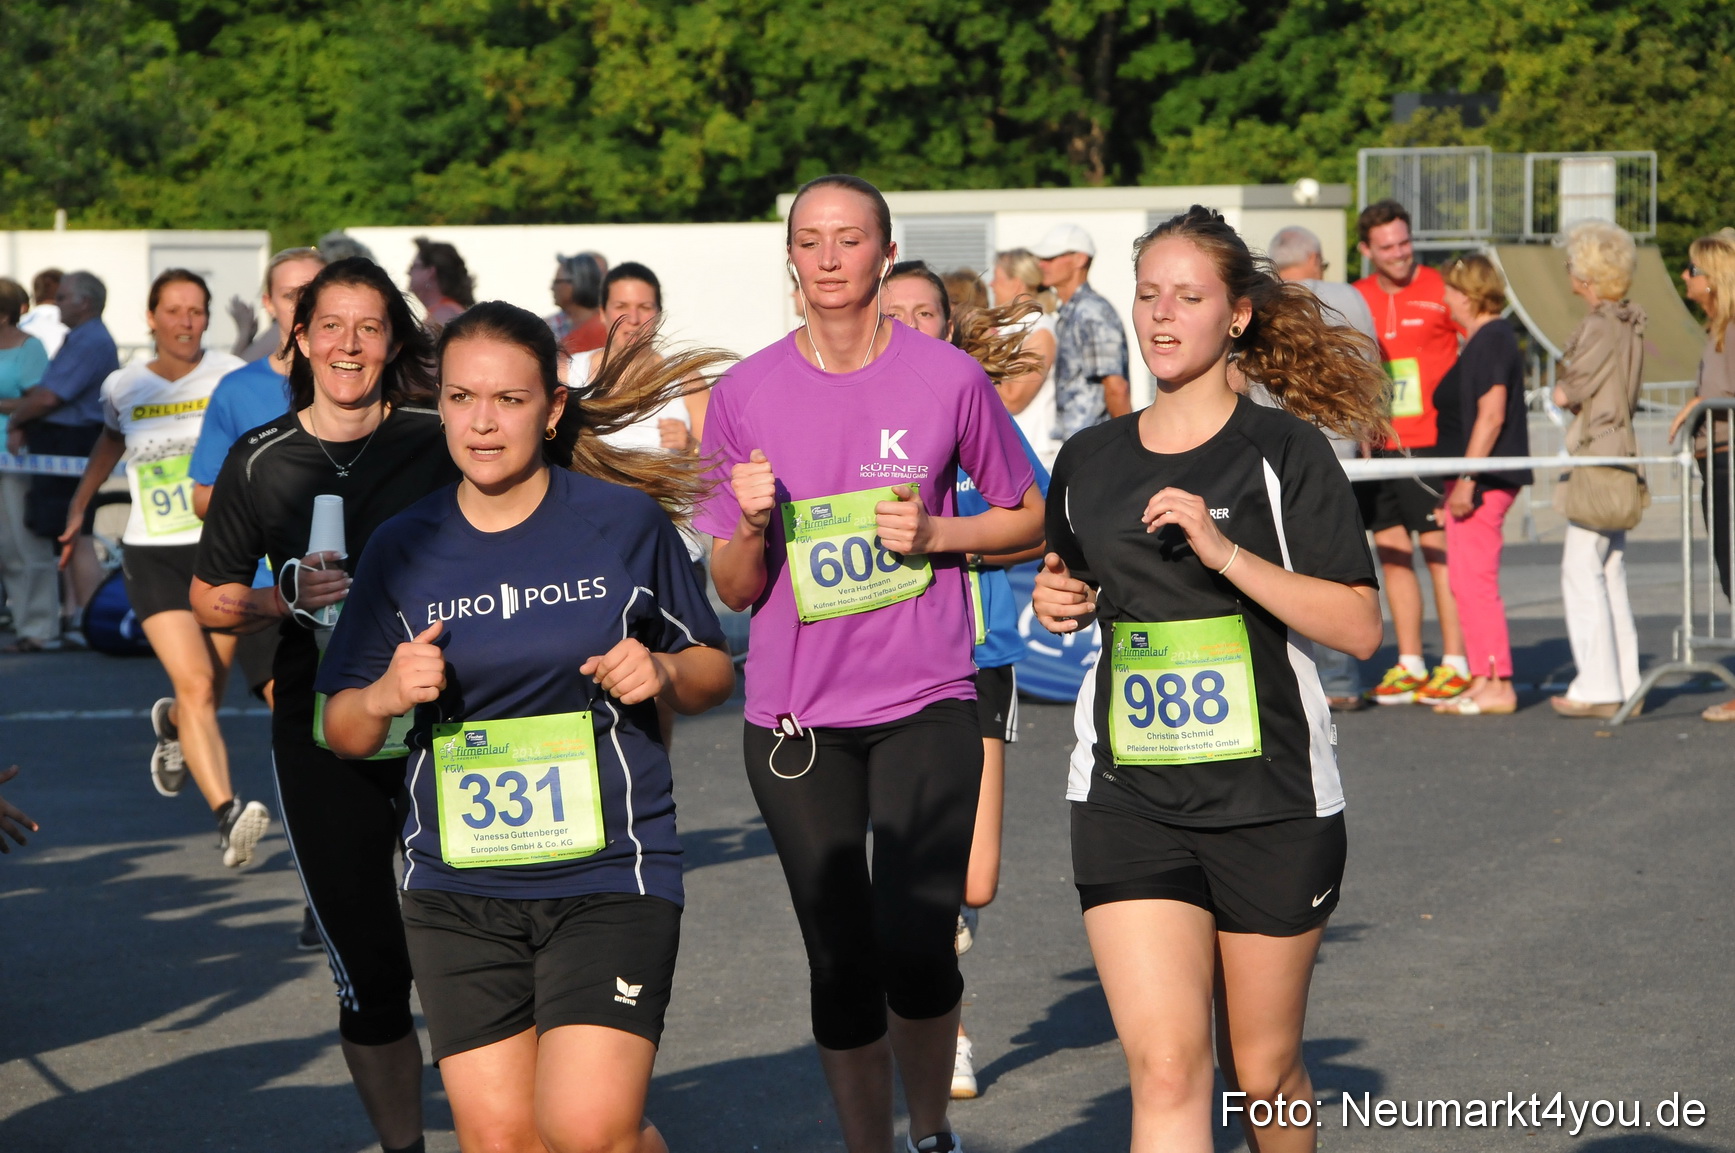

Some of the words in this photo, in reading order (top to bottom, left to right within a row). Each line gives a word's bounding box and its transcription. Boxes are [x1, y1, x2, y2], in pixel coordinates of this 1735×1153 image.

[133, 400, 204, 418] ONLINE
[258, 427, 278, 439] JAKO
[880, 429, 909, 460] K
[860, 462, 929, 473] KÜFNER
[151, 482, 196, 516] 91
[804, 513, 852, 529] firmenlauf
[1208, 507, 1230, 519] RER
[809, 534, 904, 588] 608
[813, 600, 836, 610] Küfner
[837, 598, 858, 606] Hoch-
[859, 593, 873, 601] und
[873, 586, 897, 598] Tiefbau
[897, 579, 918, 590] GmbH
[838, 587, 856, 596] Vera
[856, 578, 892, 593] Hartmann
[427, 594, 495, 624] EURO
[524, 576, 607, 609] POLES
[1124, 645, 1168, 656] firmenlauf
[1170, 650, 1200, 662] 2014
[1124, 670, 1229, 728] 988
[1146, 732, 1180, 740] Christina
[1181, 728, 1215, 739] Schmid
[456, 742, 510, 757] firmenlauf
[512, 746, 541, 759] 2014
[1126, 744, 1158, 752] Pfleiderer
[1159, 742, 1213, 752] Holzwerkstoffe
[1215, 739, 1240, 748] GmbH
[459, 766, 565, 829] 331
[473, 832, 510, 842] Vanessa
[511, 828, 569, 840] Guttenberger
[470, 844, 509, 855] Europoles
[511, 842, 535, 852] GmbH
[537, 841, 545, 849] &
[545, 840, 559, 848] Co.
[561, 838, 574, 847] KG
[614, 995, 636, 1007] erima
